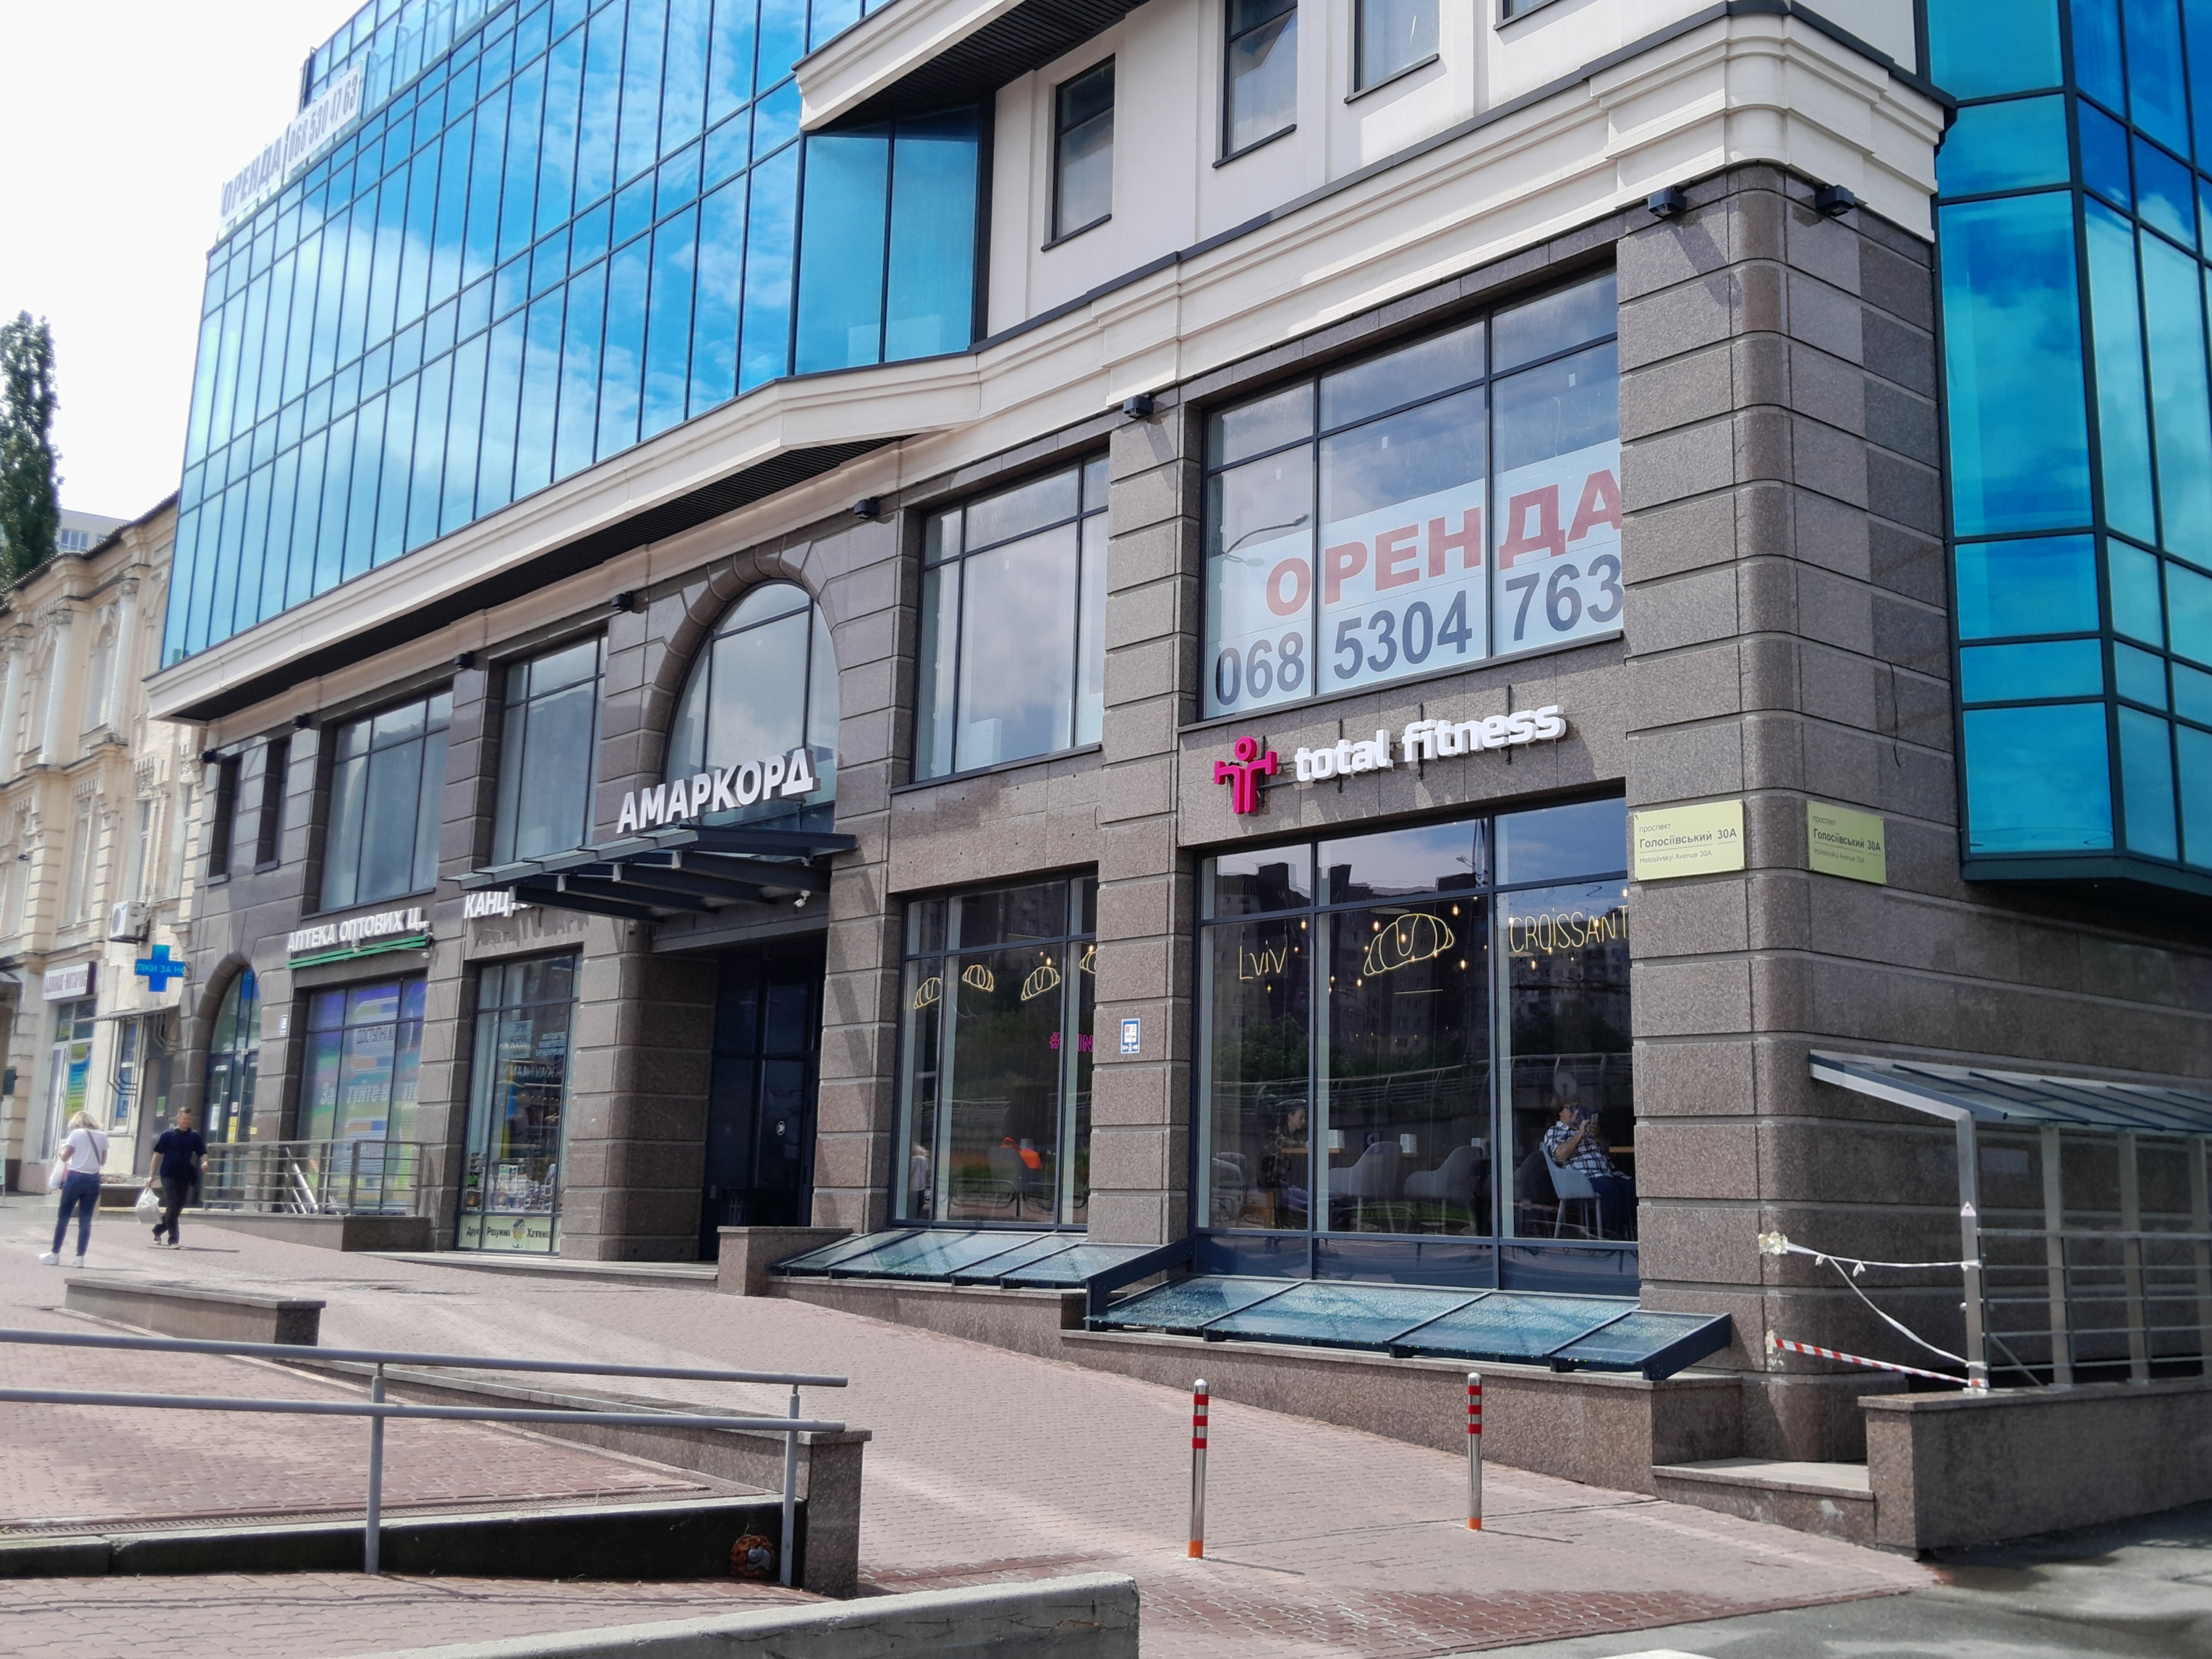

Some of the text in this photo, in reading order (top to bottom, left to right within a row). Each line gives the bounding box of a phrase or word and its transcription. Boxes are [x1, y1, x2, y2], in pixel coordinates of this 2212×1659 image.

[221, 74, 358, 218] ОРЕНДА 068 530 47 63
[1266, 469, 1622, 616] ОРЕНДА
[1215, 553, 1623, 705] 068 5304 763
[1295, 705, 1567, 783] total fitness
[616, 748, 817, 834] АМАРКОРД
[1639, 823, 1672, 834] проспект
[1640, 831, 1713, 849] Голосіївський
[1813, 828, 1865, 849] Голосіївський
[286, 923, 338, 953] АПТЕКА
[339, 909, 406, 941] ОПТОВИХ
[135, 963, 158, 973] ЛІКИ
[159, 964, 171, 973] ЗА
